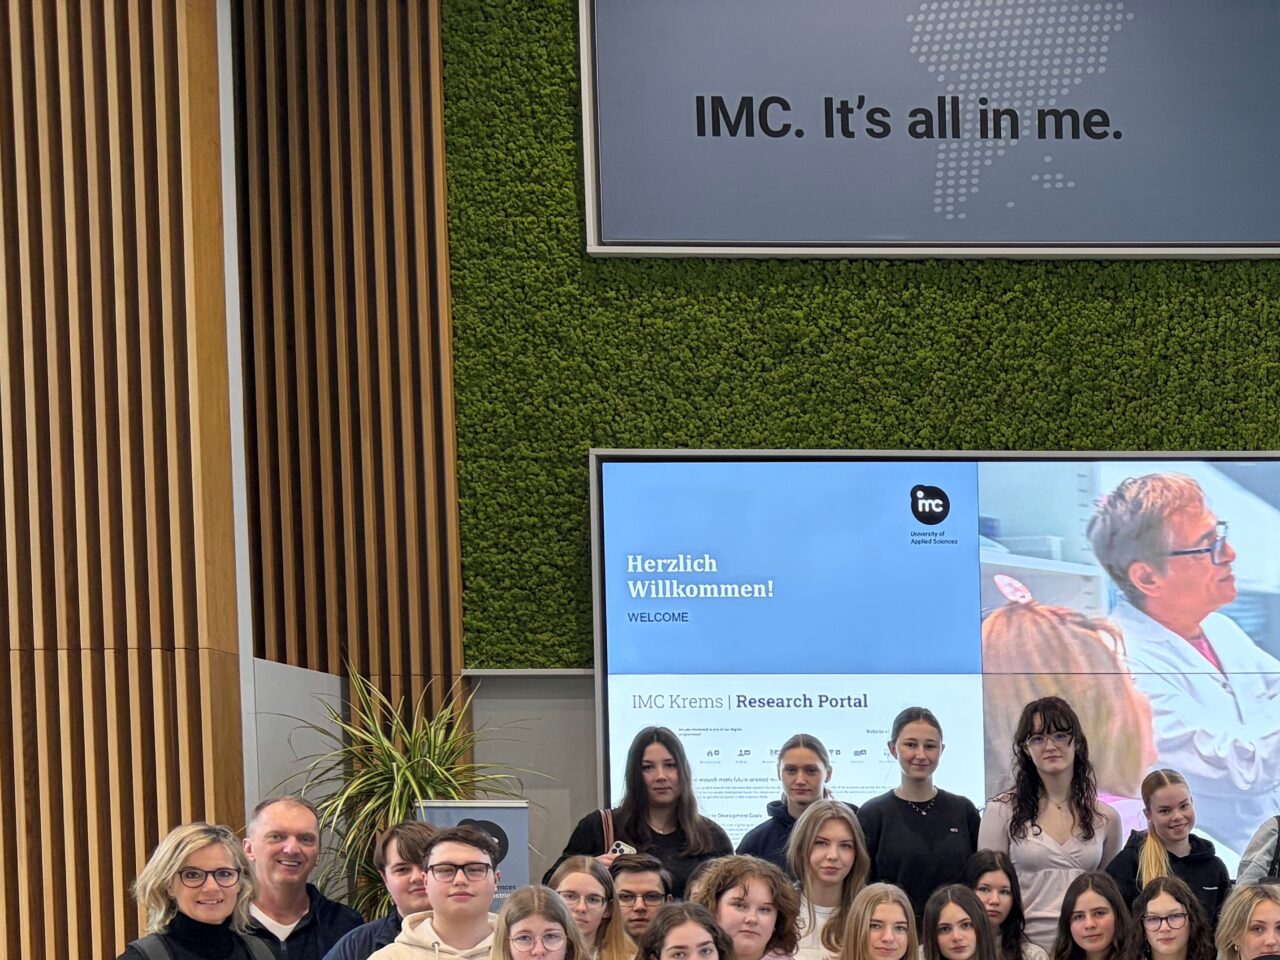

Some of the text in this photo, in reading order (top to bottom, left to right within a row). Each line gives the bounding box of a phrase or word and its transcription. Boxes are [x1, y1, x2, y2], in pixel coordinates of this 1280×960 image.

[695, 94, 1123, 140] IMC. It’s all in me.
[916, 490, 944, 512] imc
[626, 553, 718, 573] Herzlich
[626, 579, 774, 599] Willkommen!
[627, 612, 689, 623] WELCOME
[632, 694, 665, 709] IMC
[669, 694, 724, 709] Krems
[736, 694, 814, 709] Research
[817, 694, 869, 709] Portal
